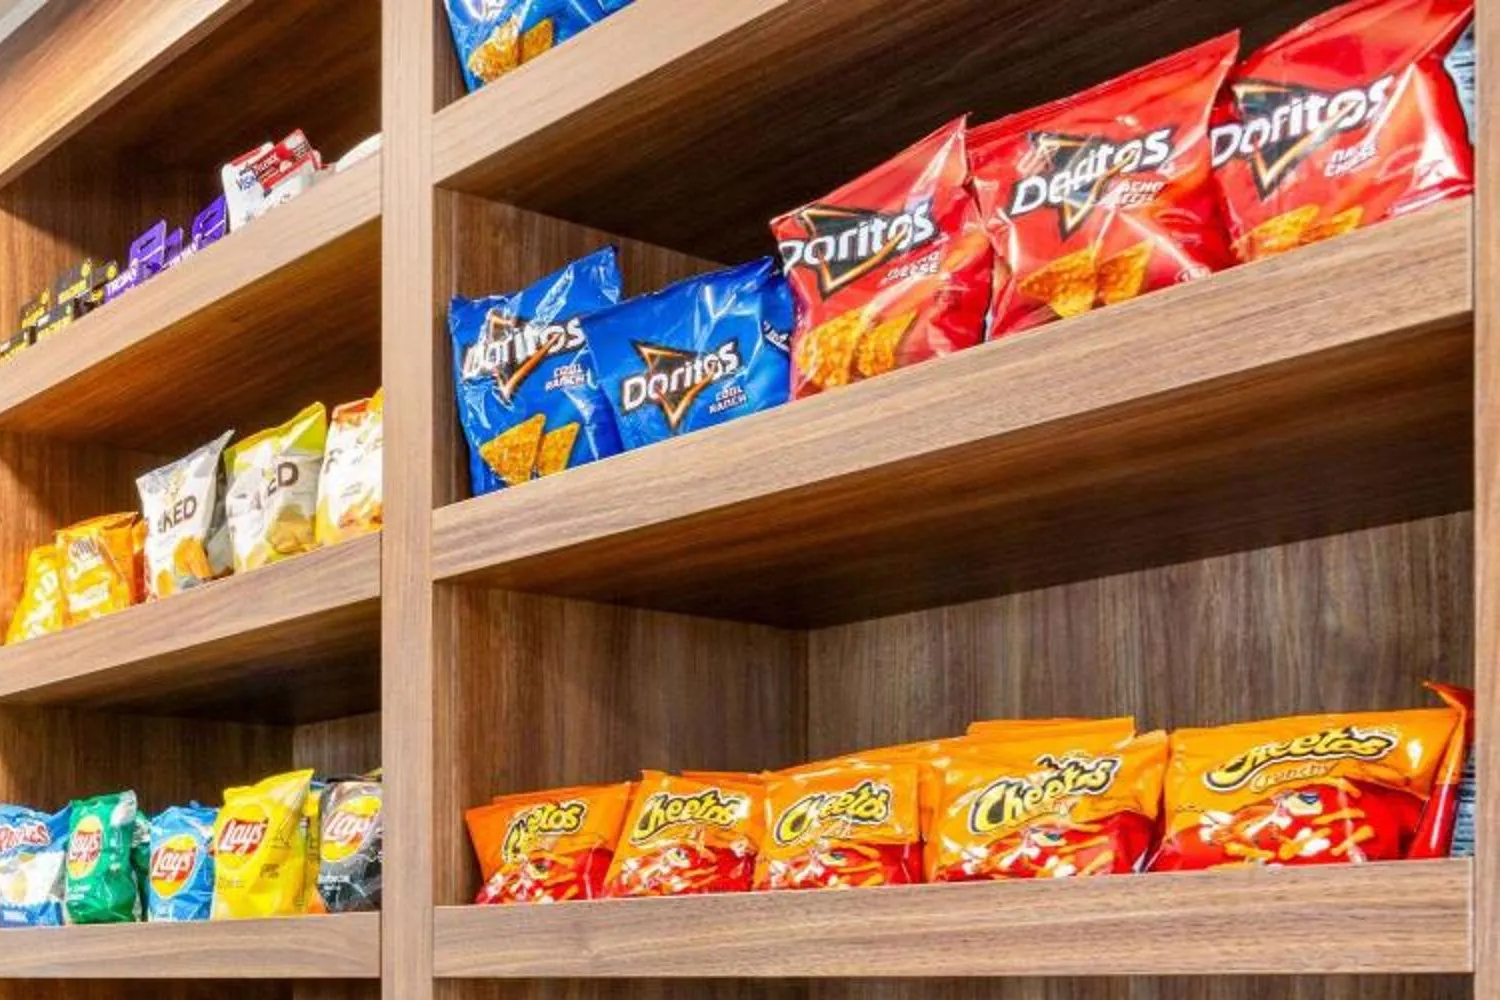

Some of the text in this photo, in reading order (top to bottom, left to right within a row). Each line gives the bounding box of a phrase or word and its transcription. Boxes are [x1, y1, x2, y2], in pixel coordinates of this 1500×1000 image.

[1211, 74, 1394, 168] Doritos
[463, 317, 587, 378] Doritos
[622, 341, 740, 411] Doritos
[1204, 726, 1399, 793] Cheetos
[631, 790, 752, 846] Cheetos
[773, 781, 893, 846] Cheetos
[969, 753, 1120, 834] Cheetos
[219, 818, 269, 854] Lay's
[503, 800, 588, 864] Cheetos
